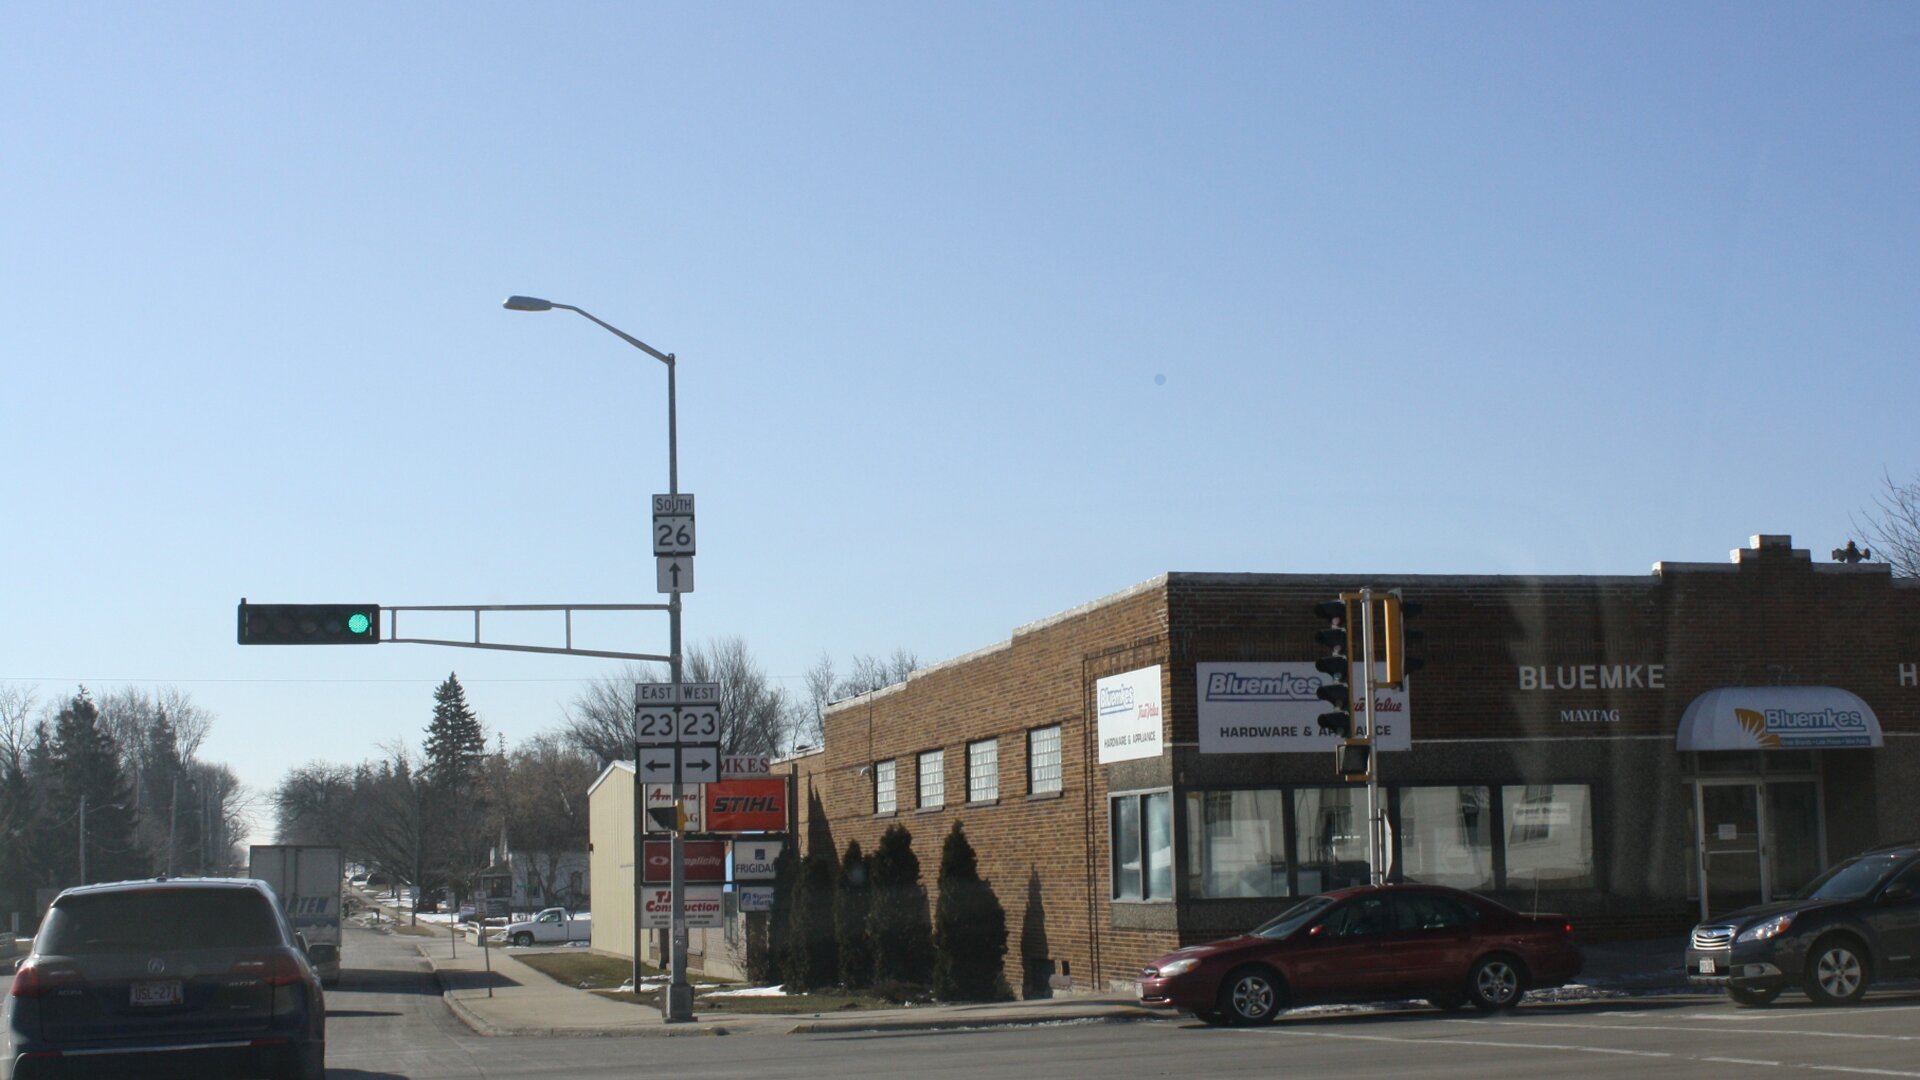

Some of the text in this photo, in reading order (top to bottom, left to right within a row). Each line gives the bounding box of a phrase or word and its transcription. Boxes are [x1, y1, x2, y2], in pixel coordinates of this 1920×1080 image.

[655, 497, 692, 511] SOUTH
[657, 524, 691, 546] 26
[1208, 672, 1323, 697] Bluemkes
[1519, 664, 1665, 690] BLUEMKE
[642, 685, 672, 699] EAST
[683, 685, 715, 699] WEST
[1560, 709, 1620, 722] MAYTAG
[1765, 707, 1863, 729] Bluemkes
[640, 713, 673, 736] 23
[683, 713, 715, 735] 23
[1219, 725, 1392, 738] HARDWARE & APACE
[1104, 735, 1127, 749] HARDWARE
[1133, 730, 1156, 744] APPLIANCE
[720, 757, 769, 773] MKES
[650, 788, 697, 801] Amna
[712, 795, 780, 813] STIHL
[735, 863, 775, 873] FRIGIDAI
[645, 900, 720, 912] Conuction
